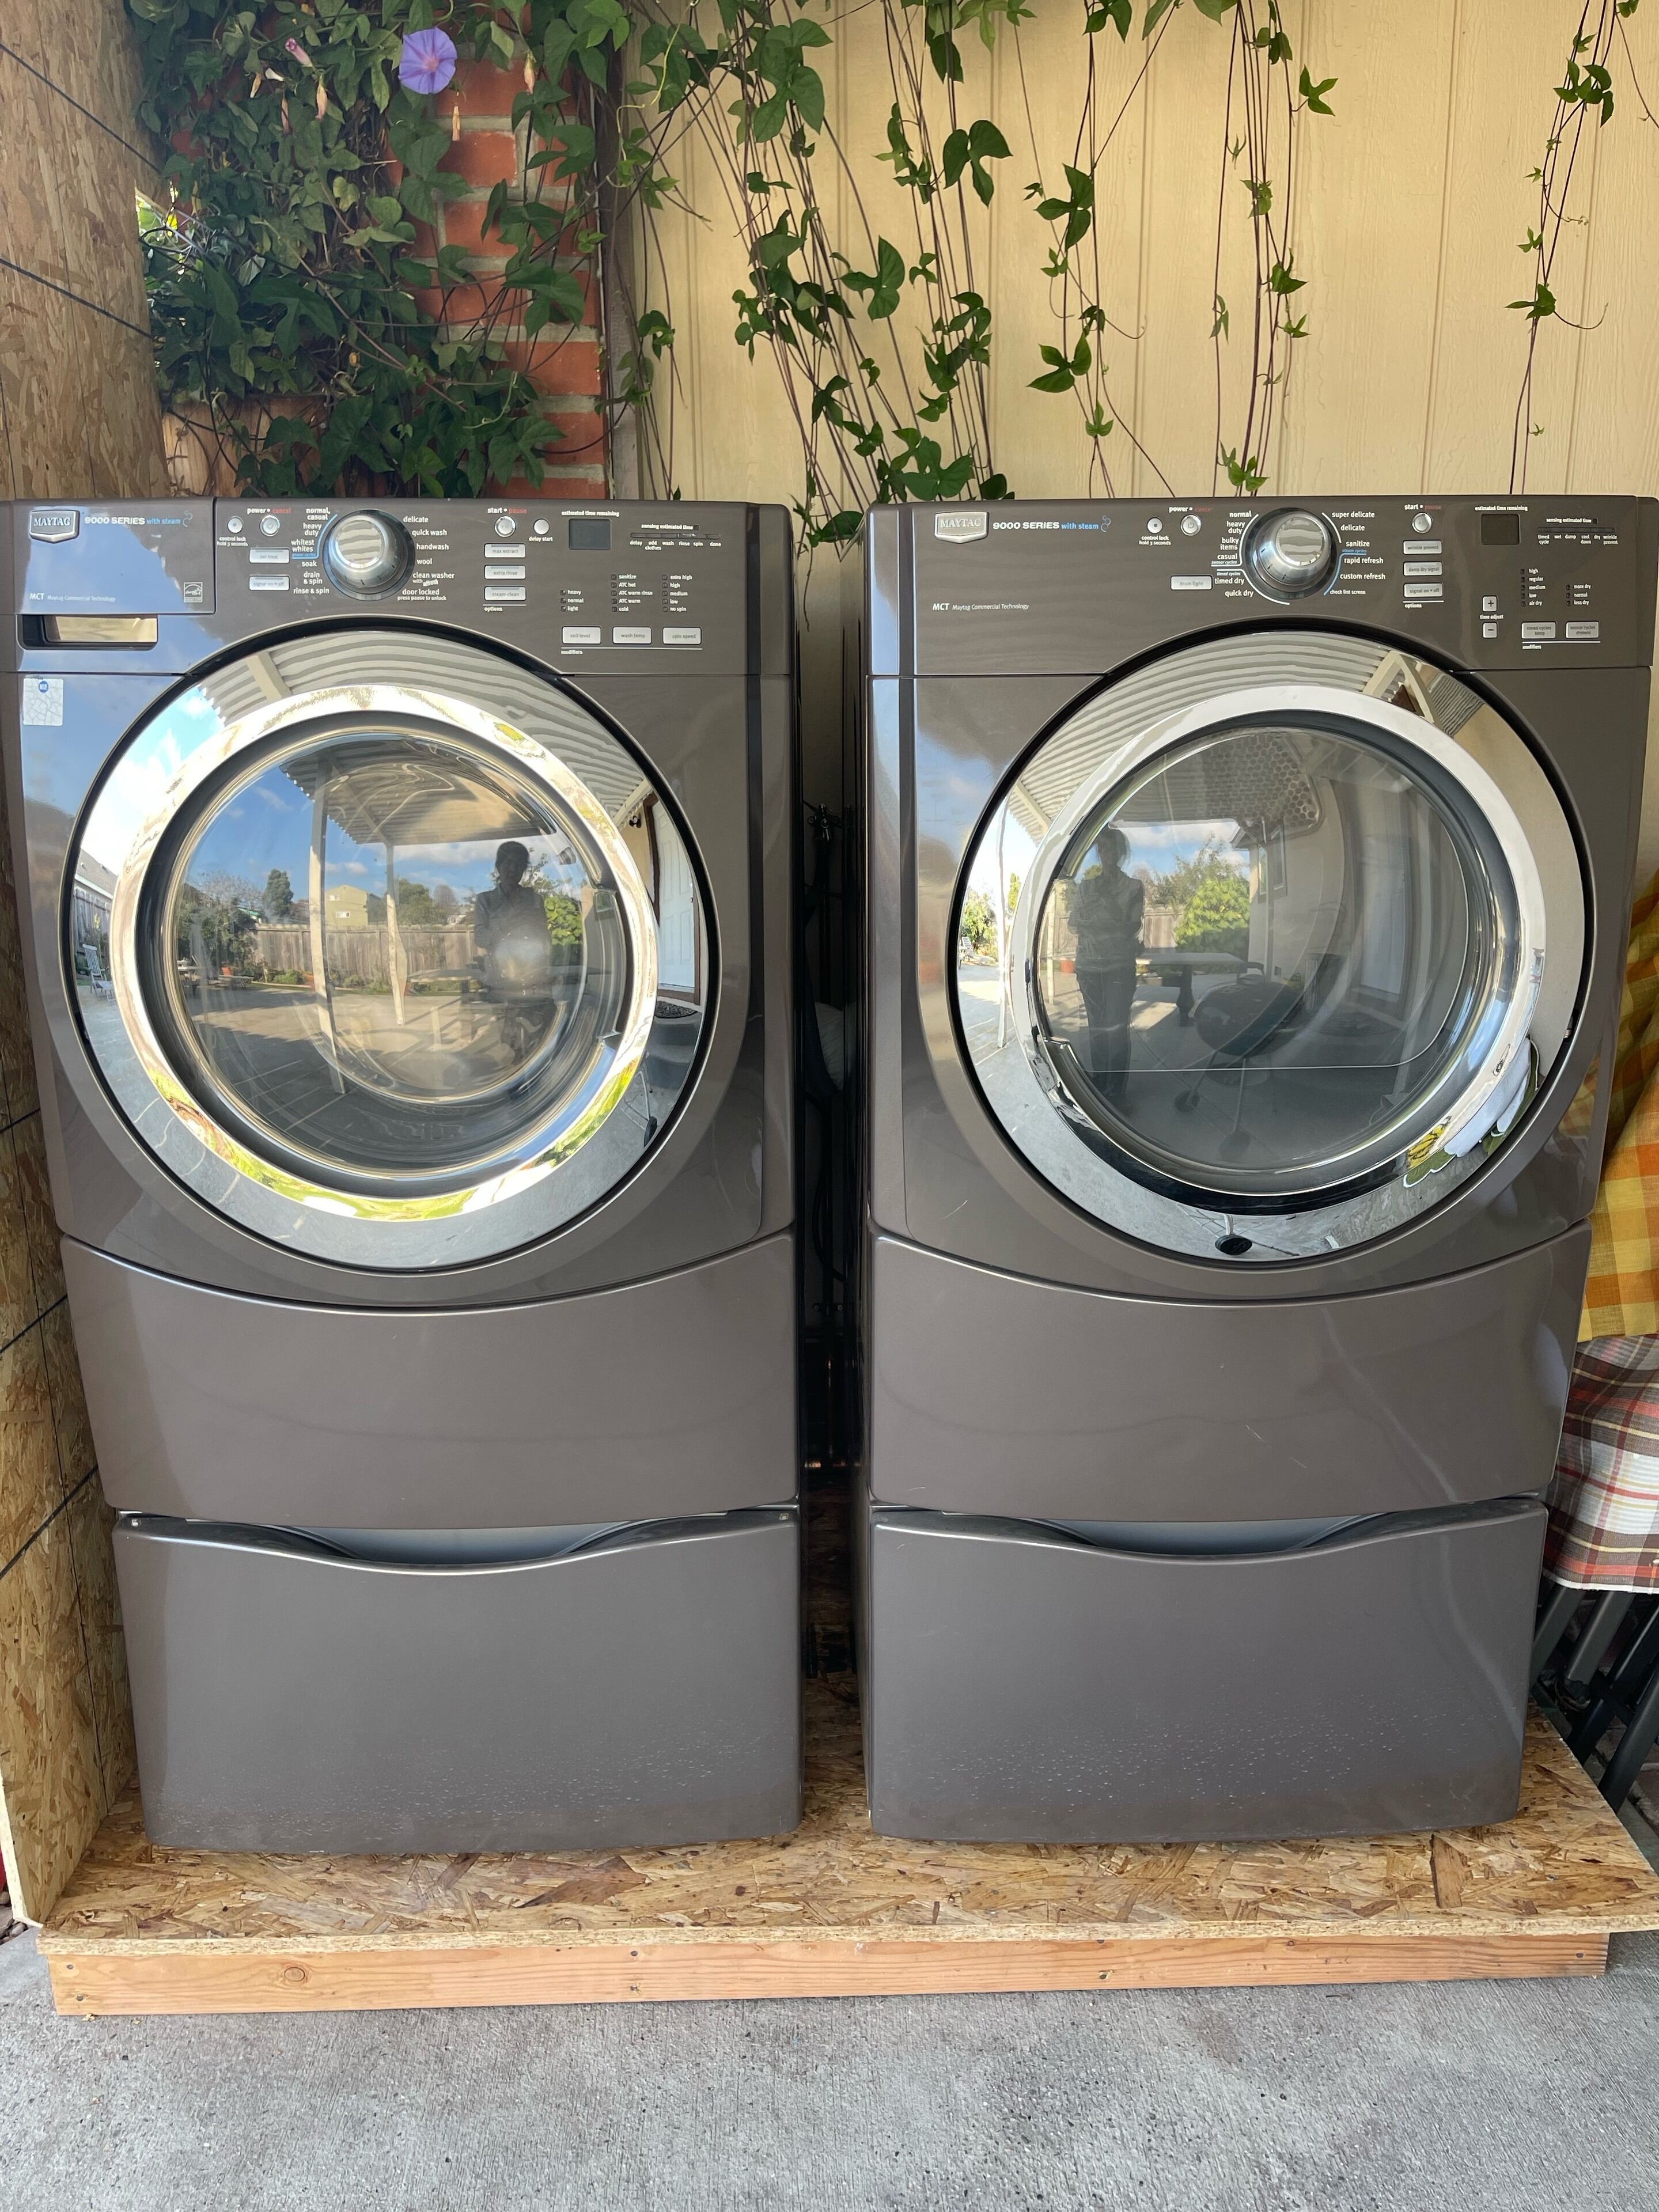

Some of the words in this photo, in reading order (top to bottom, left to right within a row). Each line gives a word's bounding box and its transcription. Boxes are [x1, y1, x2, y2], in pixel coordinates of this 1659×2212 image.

[34, 517, 70, 526] MAYTAG
[111, 517, 145, 525] SERIES
[940, 518, 981, 528] MAYTAG
[1022, 521, 1059, 529] SERIES
